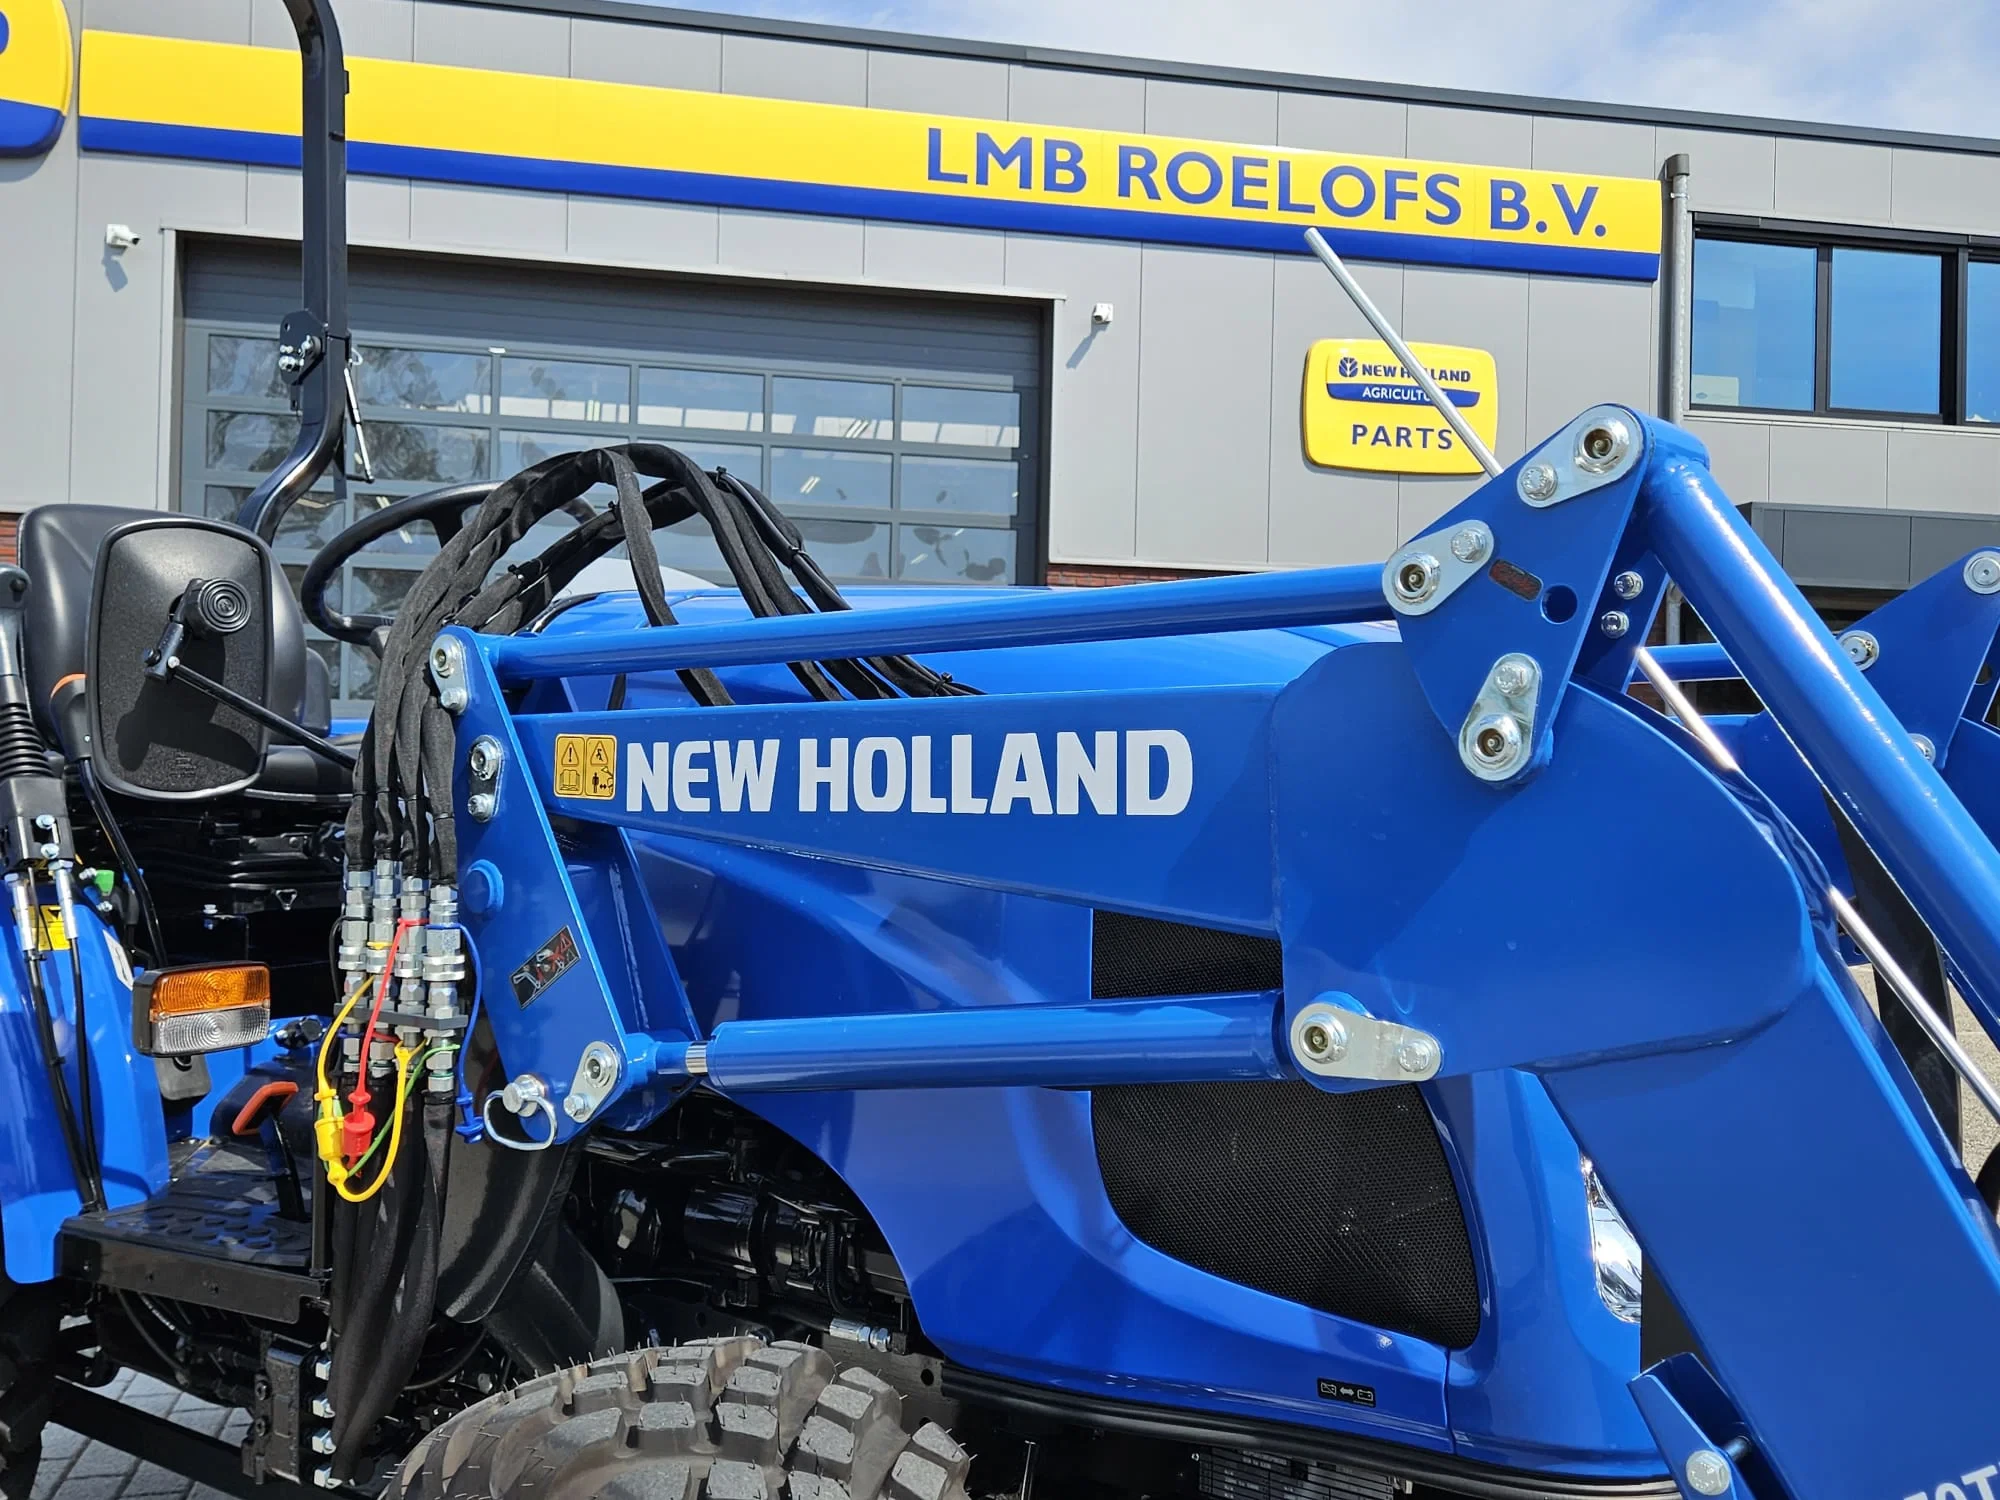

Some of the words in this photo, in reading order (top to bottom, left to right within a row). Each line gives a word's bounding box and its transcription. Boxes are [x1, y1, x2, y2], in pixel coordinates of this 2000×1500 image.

[928, 127, 1087, 194] LMB
[1119, 145, 1463, 226] ROELOFS
[1490, 179, 1607, 237] B.V.
[1362, 364, 1396, 378] NEW
[1400, 366, 1471, 382] HLAND
[1352, 424, 1453, 450] PARTS
[626, 738, 780, 812] NEW
[799, 729, 1193, 816] HOLLAND
